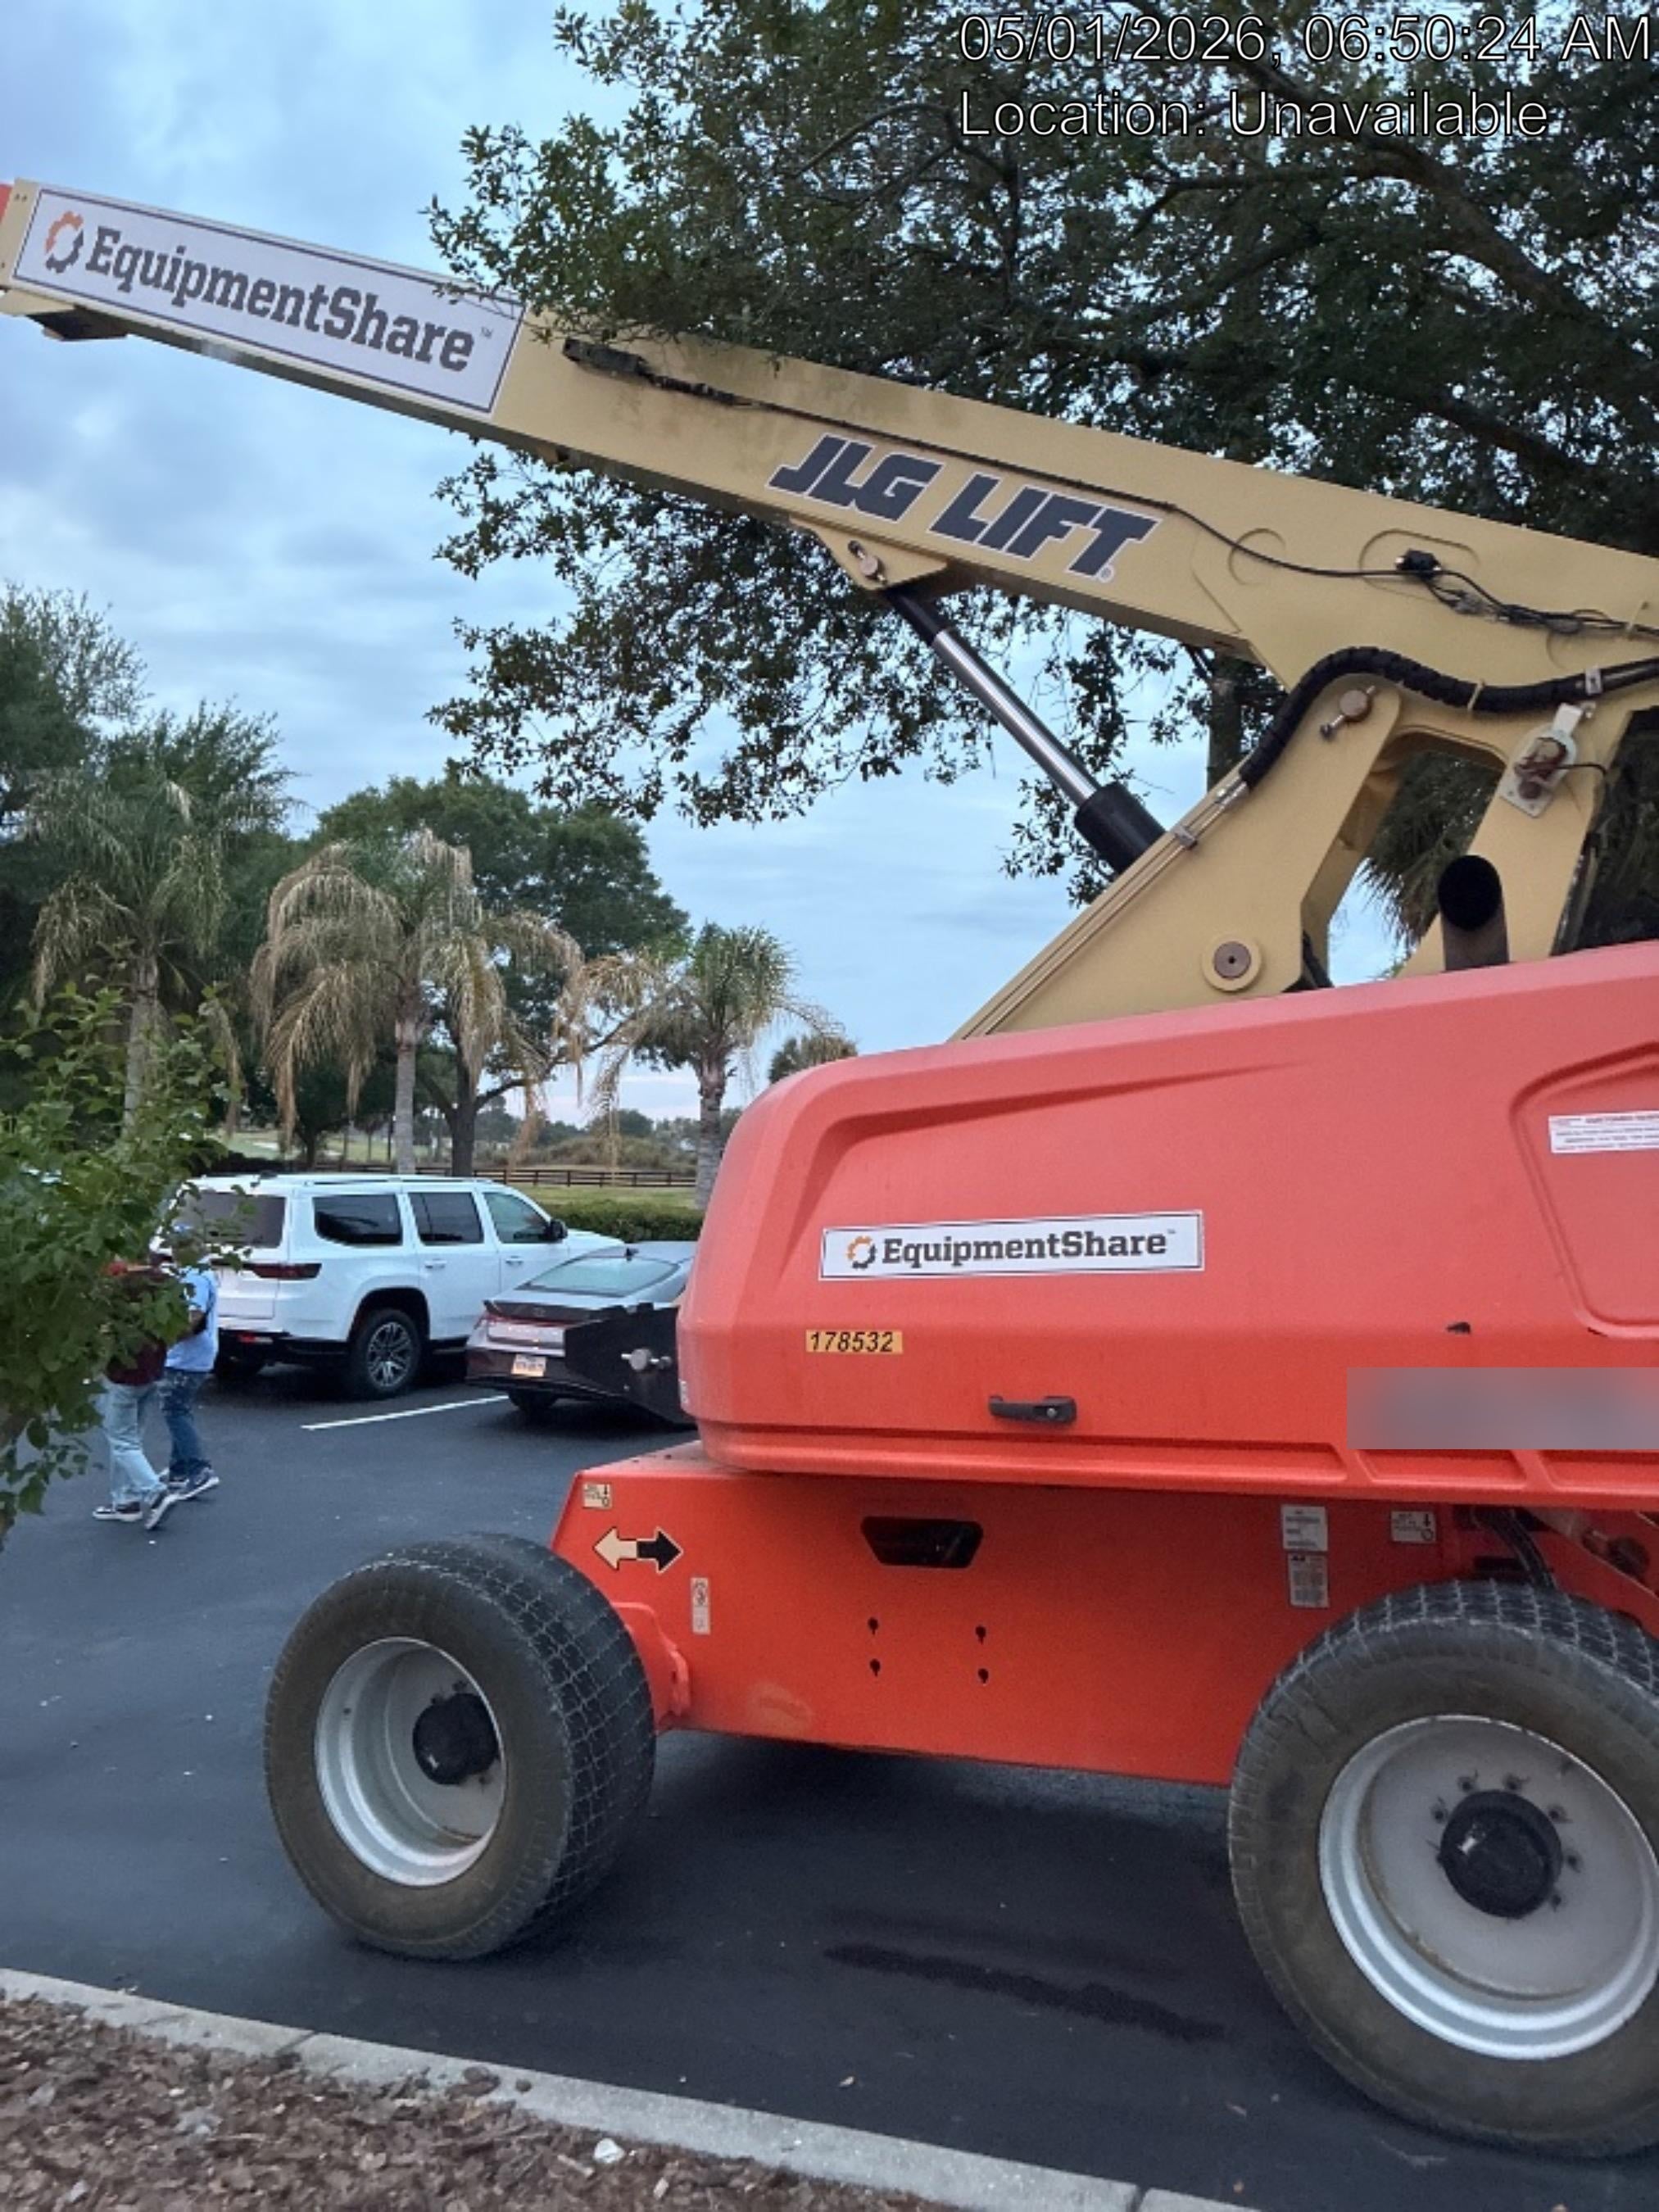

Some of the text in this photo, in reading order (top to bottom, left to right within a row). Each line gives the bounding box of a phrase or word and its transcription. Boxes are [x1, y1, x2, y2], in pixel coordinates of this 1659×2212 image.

[85, 225, 474, 371] EquipmentShare
[765, 433, 1163, 577] JLG LIFT
[882, 1231, 1167, 1268] EquipmentShare
[809, 1331, 894, 1353] 178532
